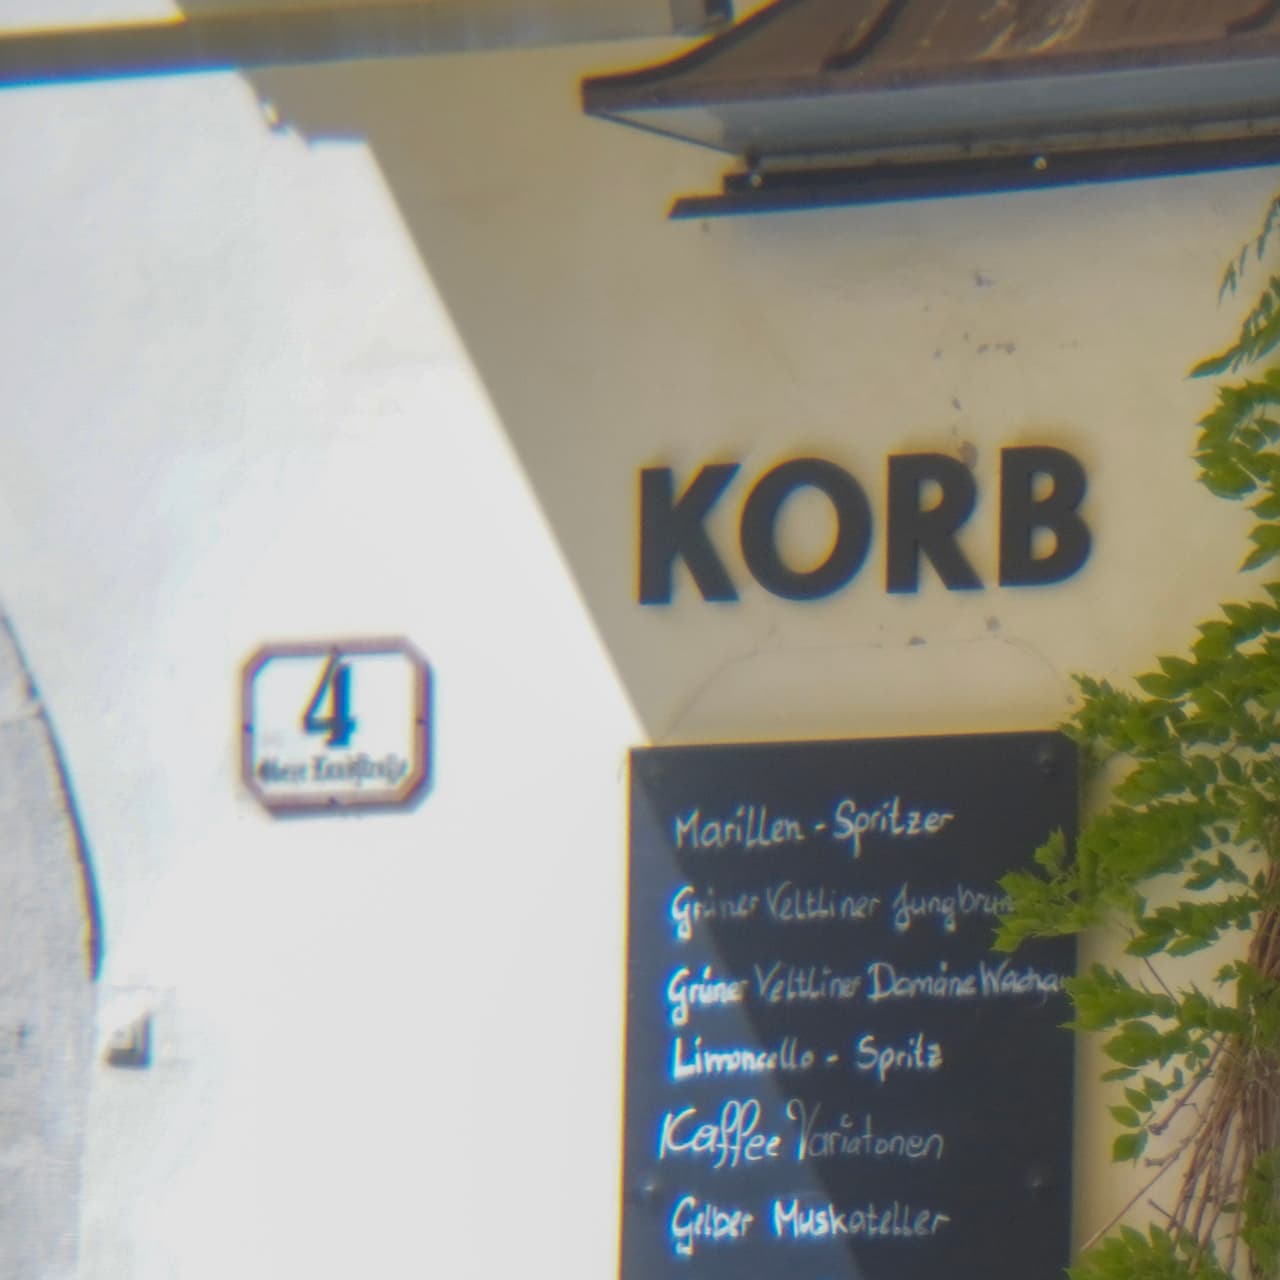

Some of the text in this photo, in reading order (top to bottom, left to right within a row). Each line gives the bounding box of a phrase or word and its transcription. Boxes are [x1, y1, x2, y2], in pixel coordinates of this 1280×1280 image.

[639, 445, 1092, 605] KORB
[303, 652, 357, 747] 4
[675, 806, 803, 848] Marillen
[833, 796, 954, 858] Spritzer
[767, 880, 880, 920] Veltliner
[753, 961, 860, 1001] Veltliner
[672, 1037, 814, 1081] Limoncello
[856, 1031, 944, 1081] Spritz
[660, 1099, 780, 1168] Kaffee
[671, 1196, 951, 1256] Gelber Muskateller
